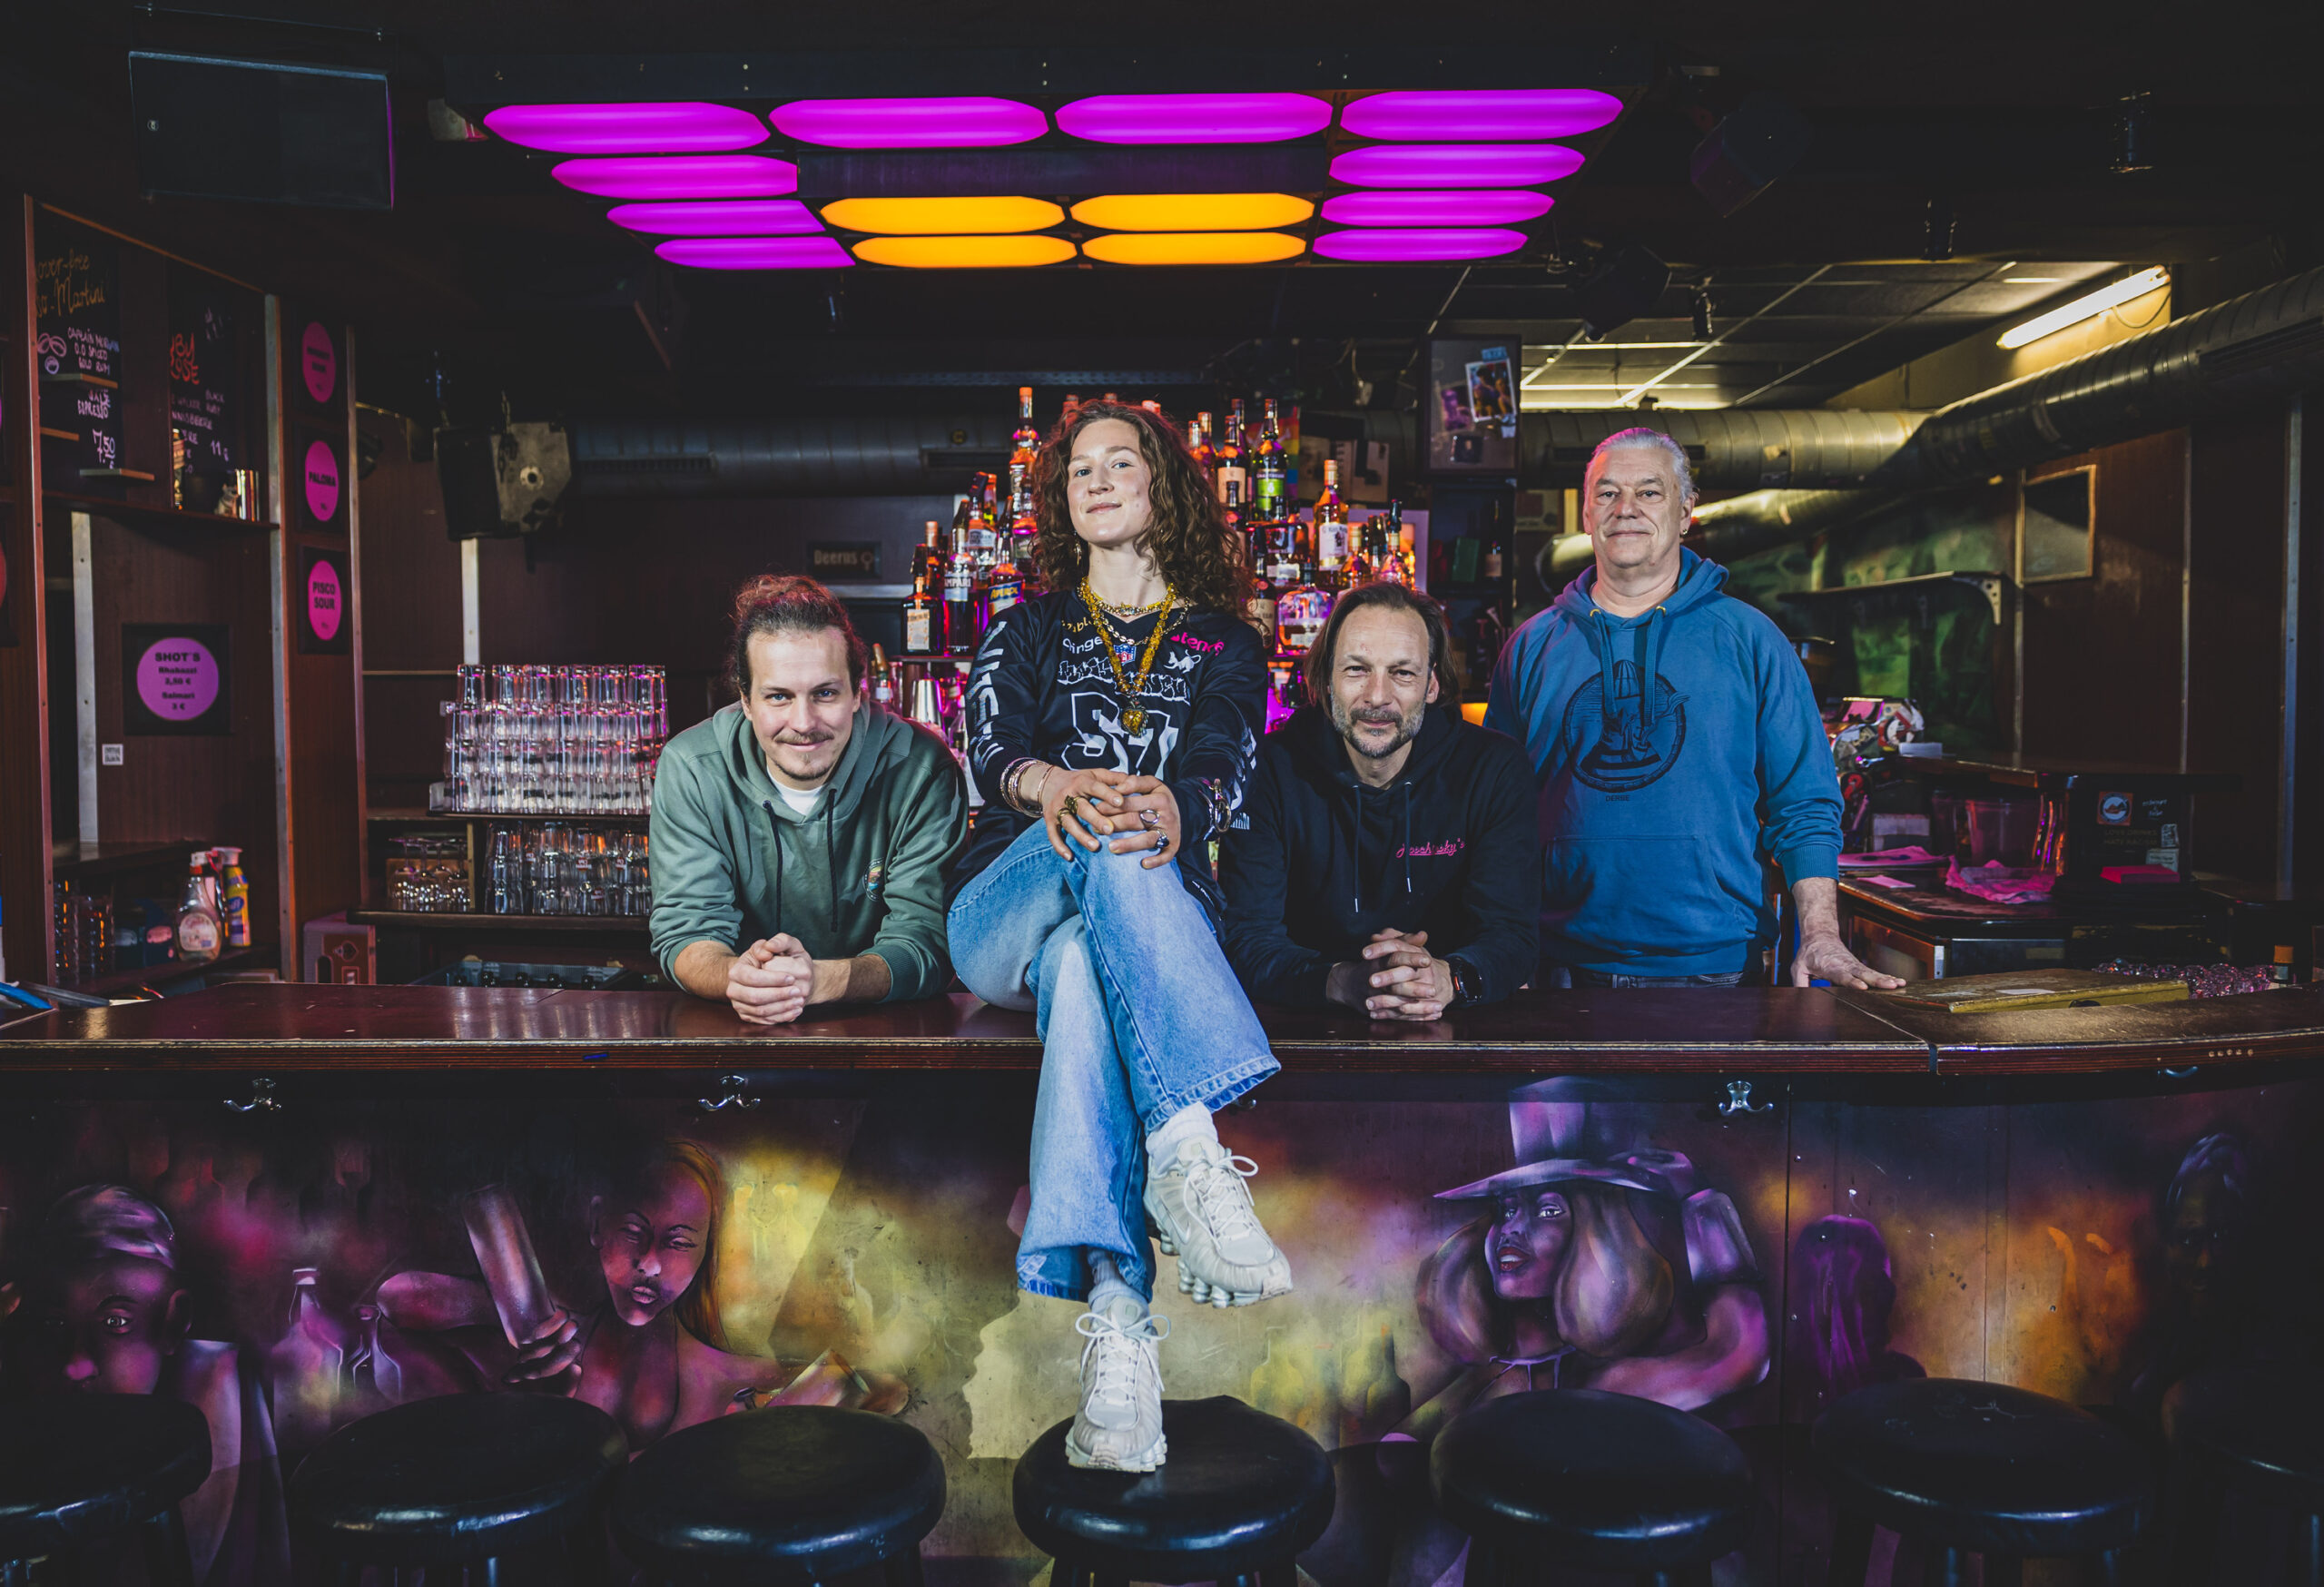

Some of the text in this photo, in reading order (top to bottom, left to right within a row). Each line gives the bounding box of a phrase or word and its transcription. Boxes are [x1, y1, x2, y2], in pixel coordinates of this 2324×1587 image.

[309, 471, 336, 487] PALOMA
[312, 581, 335, 595] PISCO
[990, 586, 1019, 600] APEROL
[314, 596, 335, 610] SOUR
